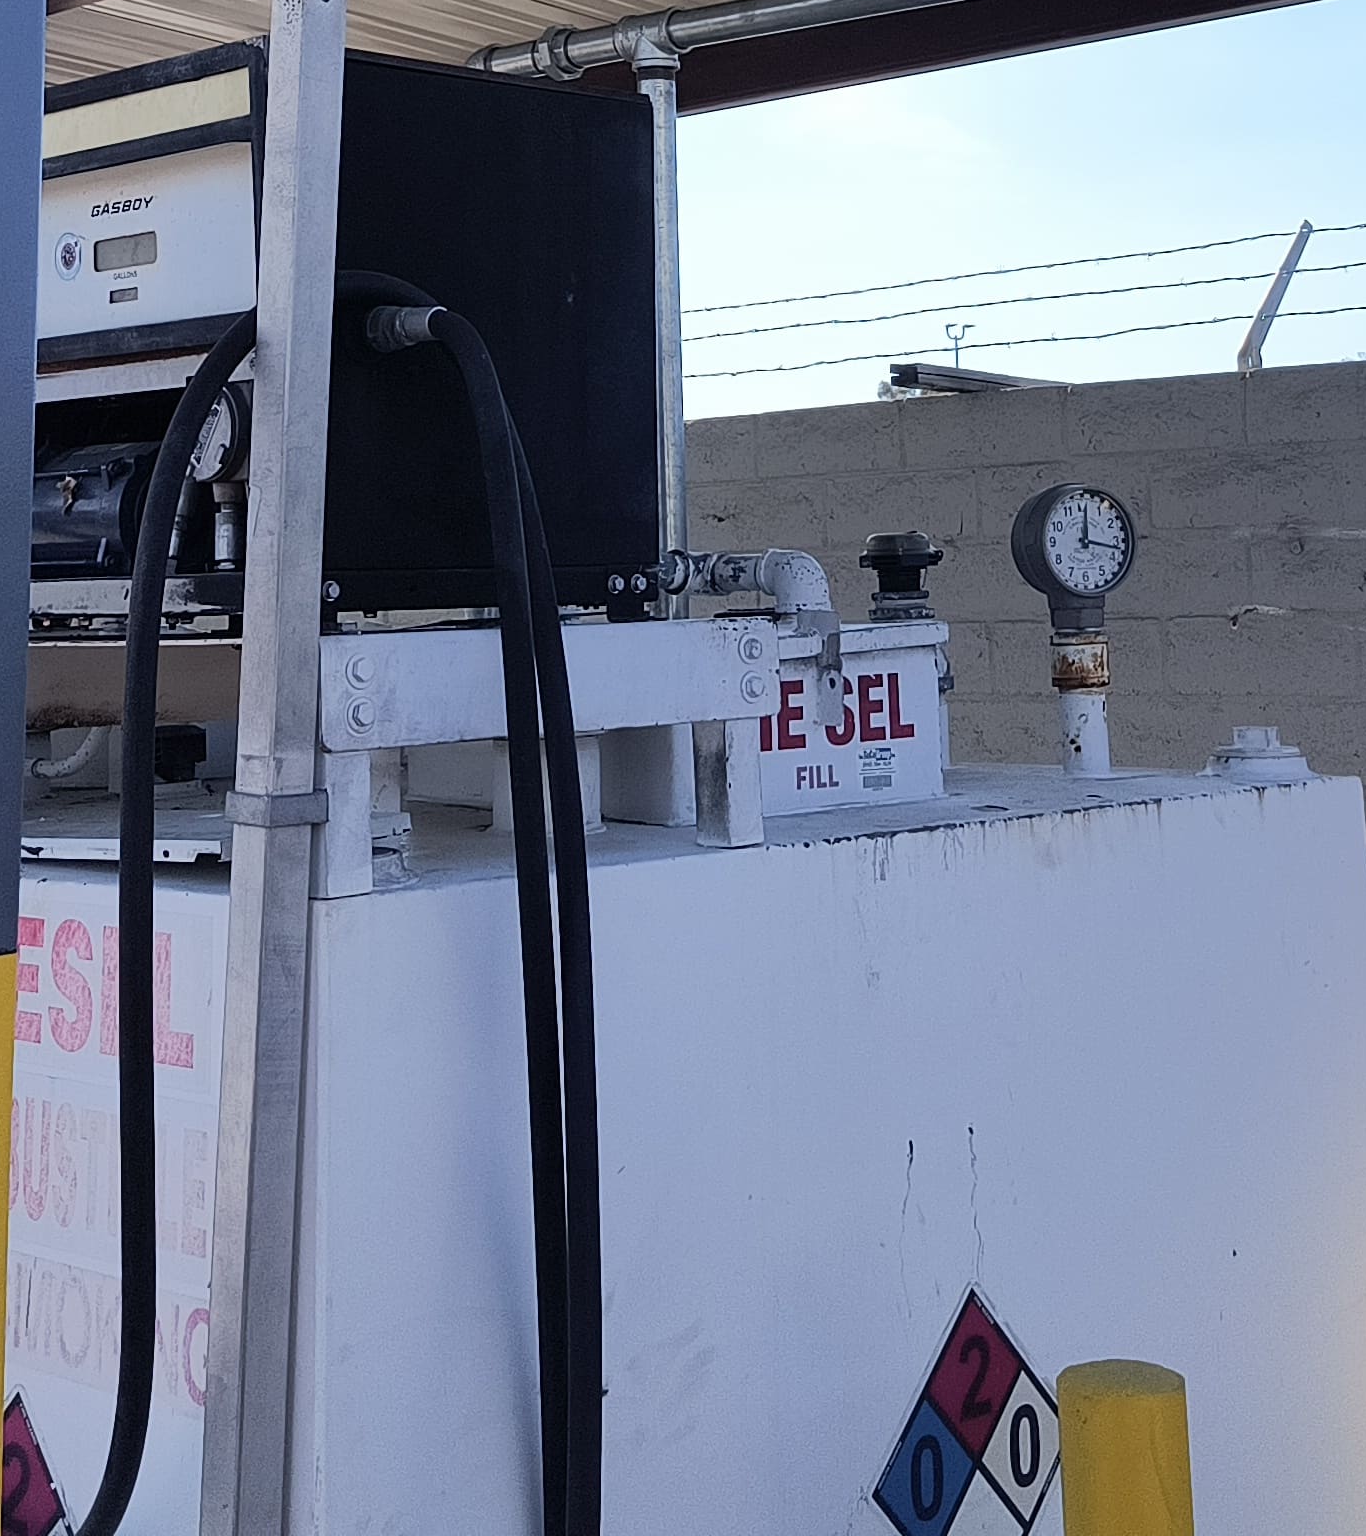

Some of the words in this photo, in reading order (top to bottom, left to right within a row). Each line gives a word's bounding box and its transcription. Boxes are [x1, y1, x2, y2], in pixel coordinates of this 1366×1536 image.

[90, 195, 155, 218] GASBOY
[1063, 506, 1073, 517] 11
[1052, 520, 1063, 532] 10
[1107, 518, 1114, 529] 2
[1049, 536, 1056, 547] 9
[1055, 553, 1062, 564] 8
[1068, 566, 1075, 577] 7
[1098, 565, 1106, 576] 5
[1082, 571, 1090, 582] 6
[796, 764, 840, 790] FILL
[959, 1335, 993, 1422] 2
[1009, 1403, 1041, 1488] 0
[910, 1435, 944, 1522] 0
